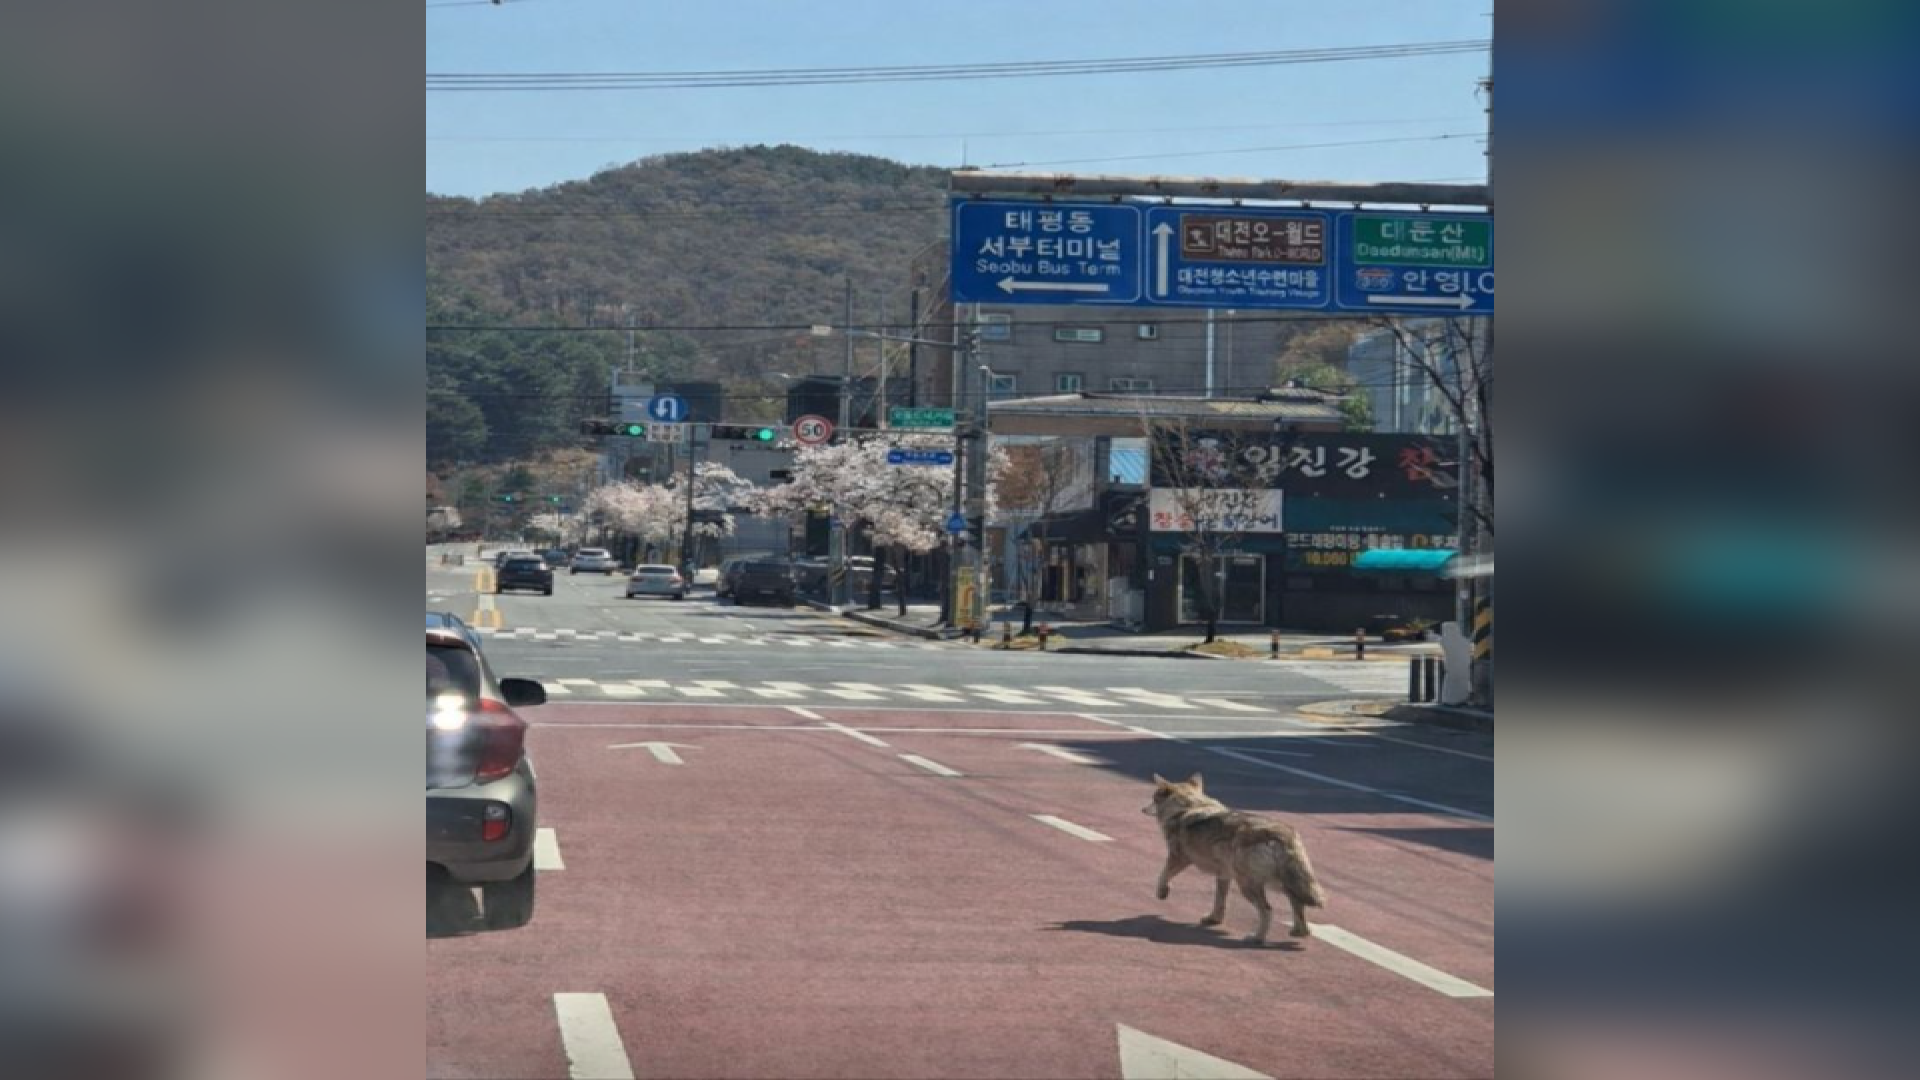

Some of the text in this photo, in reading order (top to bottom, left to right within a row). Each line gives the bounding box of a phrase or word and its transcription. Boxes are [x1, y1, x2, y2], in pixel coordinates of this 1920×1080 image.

[1005, 210, 1094, 233] 태평동
[1380, 221, 1465, 244] 대둔산
[978, 236, 1121, 262] 서부터미널
[976, 258, 1121, 276] Seobu Bus Term
[803, 423, 822, 436] 50
[1244, 446, 1377, 481] 임진강
